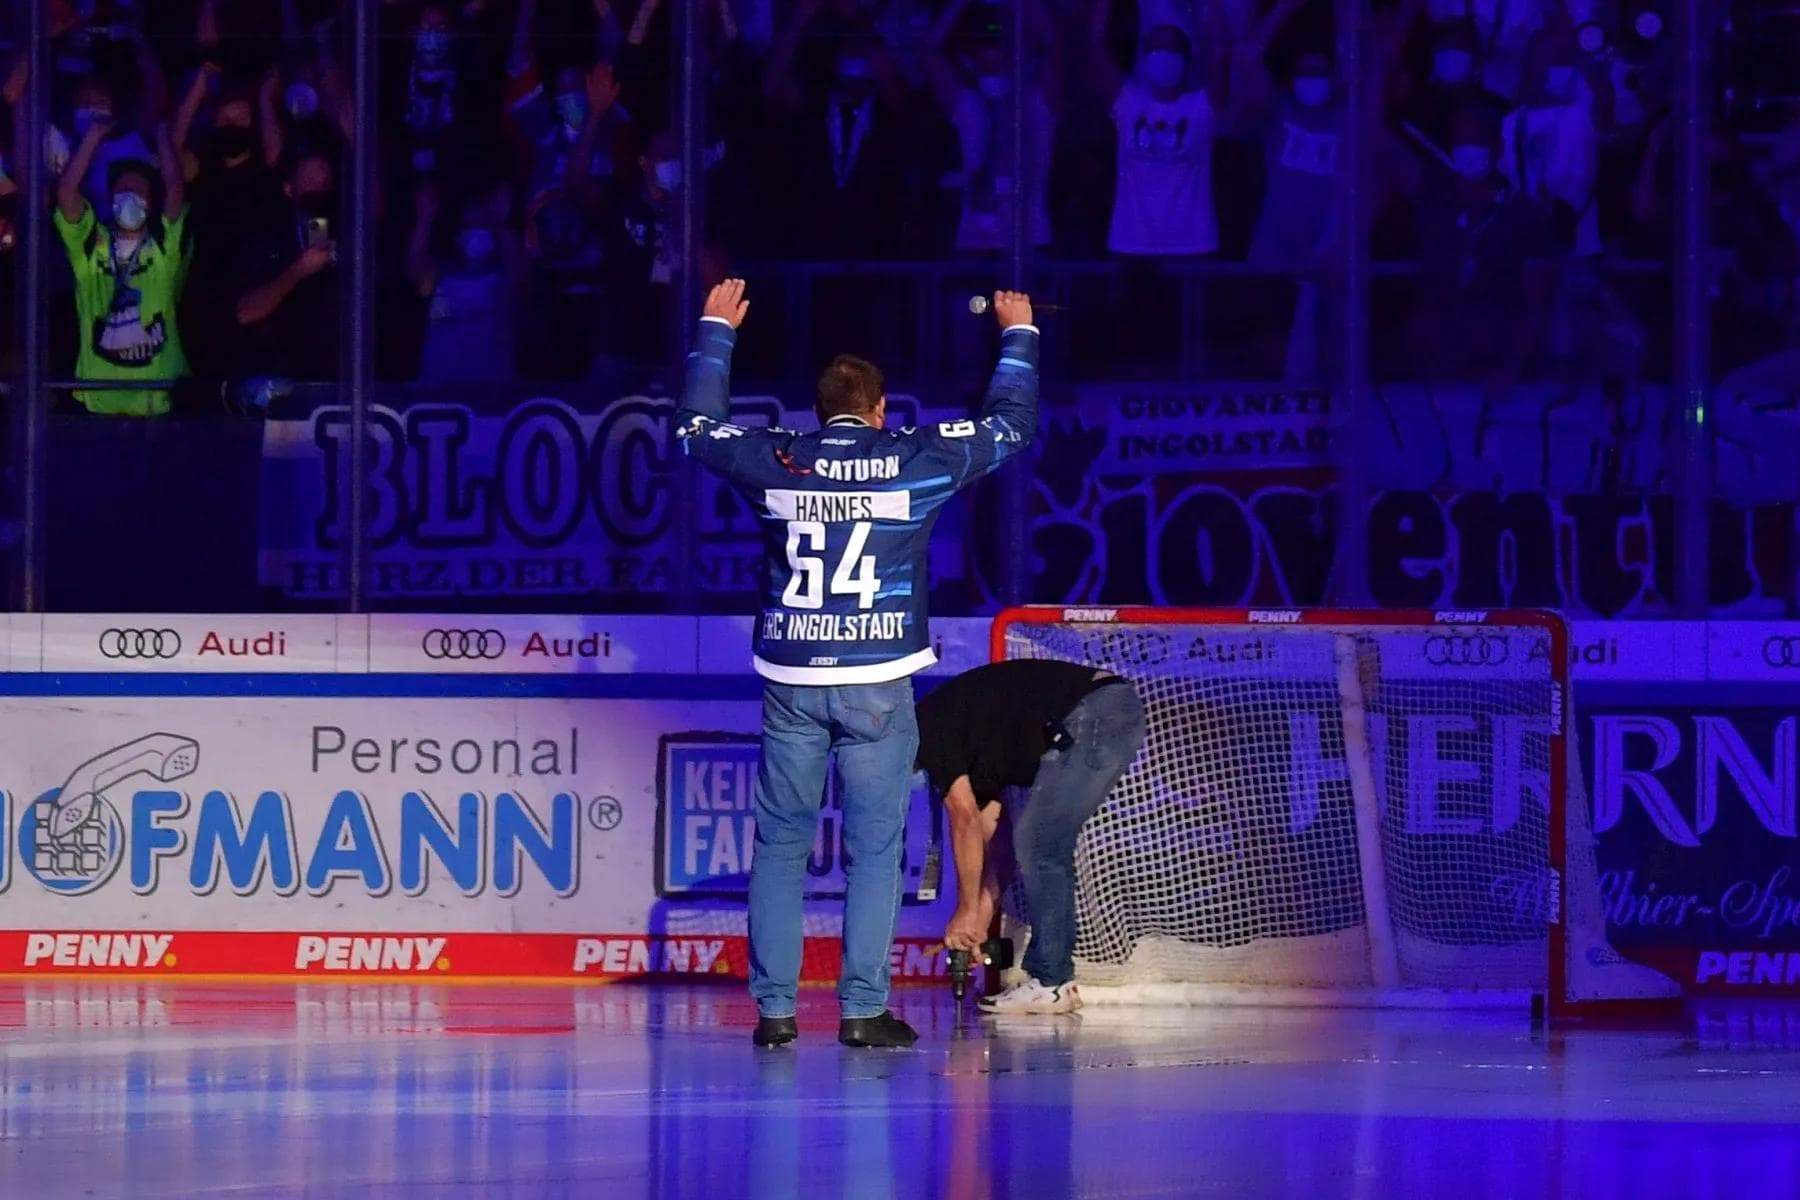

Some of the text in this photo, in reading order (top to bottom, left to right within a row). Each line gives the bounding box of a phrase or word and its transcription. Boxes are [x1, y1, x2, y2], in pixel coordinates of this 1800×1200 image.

[1119, 428, 1331, 460] INGOLSTAD
[815, 455, 900, 482] SATURN
[796, 496, 872, 522] HANNES
[291, 558, 450, 593] HRZ
[782, 521, 881, 609] 64
[787, 611, 905, 641] INGOLSTADT
[1063, 609, 1118, 622] PENNY
[1248, 610, 1302, 623] PENNY
[1434, 610, 1487, 623] PENNY
[198, 630, 286, 656] Audi
[522, 631, 611, 658] Audi
[1187, 635, 1276, 663] Audi
[311, 726, 579, 776] Personal
[684, 761, 758, 811] KEI
[0, 788, 582, 898] OFMANN
